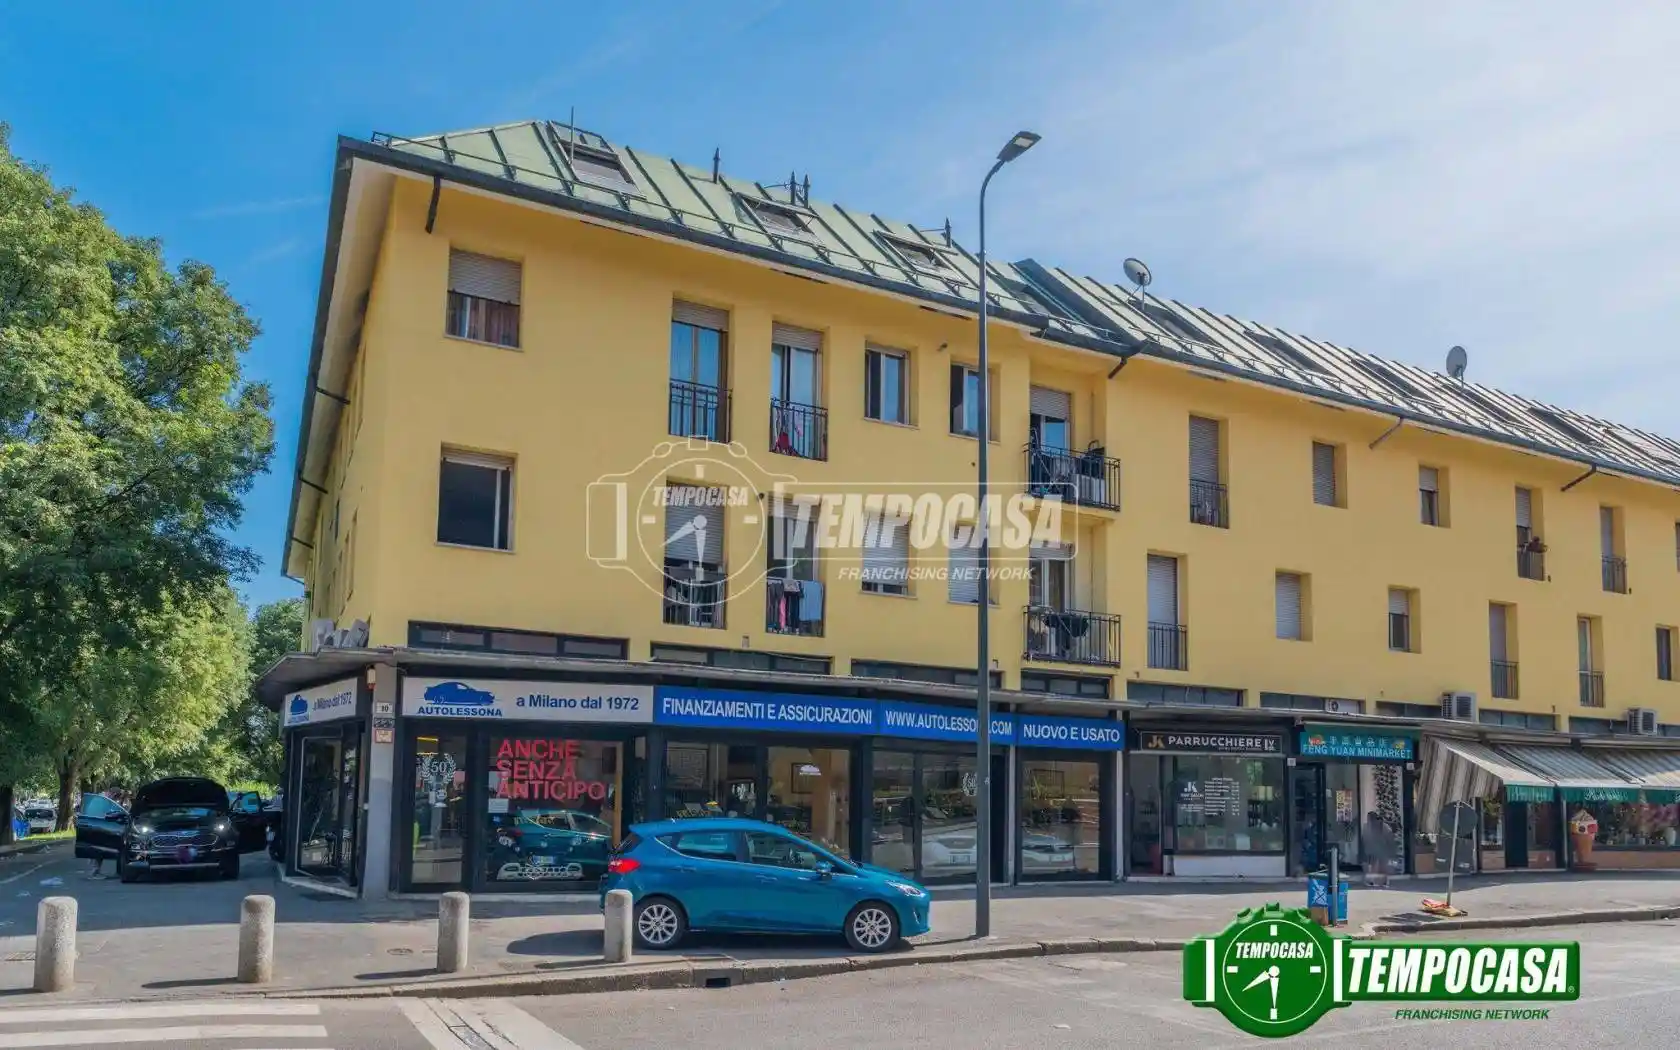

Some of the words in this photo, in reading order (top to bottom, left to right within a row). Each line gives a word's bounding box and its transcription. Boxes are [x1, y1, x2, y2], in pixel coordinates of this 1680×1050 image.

[418, 706, 502, 717] AUTOLESSONA
[516, 698, 525, 707] a
[529, 694, 577, 709] Milano
[581, 696, 602, 709] dal
[607, 697, 639, 710] 1972
[662, 697, 765, 719] FINANZIAMENTI
[767, 703, 776, 720] E
[778, 704, 872, 724] ASSICURAZIONI
[885, 710, 1012, 736] WWW.AUTOLESSO.COM
[1023, 723, 1068, 740] NUOVO
[1070, 727, 1079, 740] E
[1081, 727, 1120, 742] USATO
[498, 739, 580, 759] ANCHE
[1168, 736, 1262, 748] PARRUCCHIERE
[1302, 744, 1328, 755] FENG
[1330, 746, 1355, 757] YUAN
[1357, 747, 1412, 760] MINIMARKET
[430, 761, 448, 773] 50
[496, 759, 577, 780] SENZA
[496, 780, 606, 800] ANTICIPO
